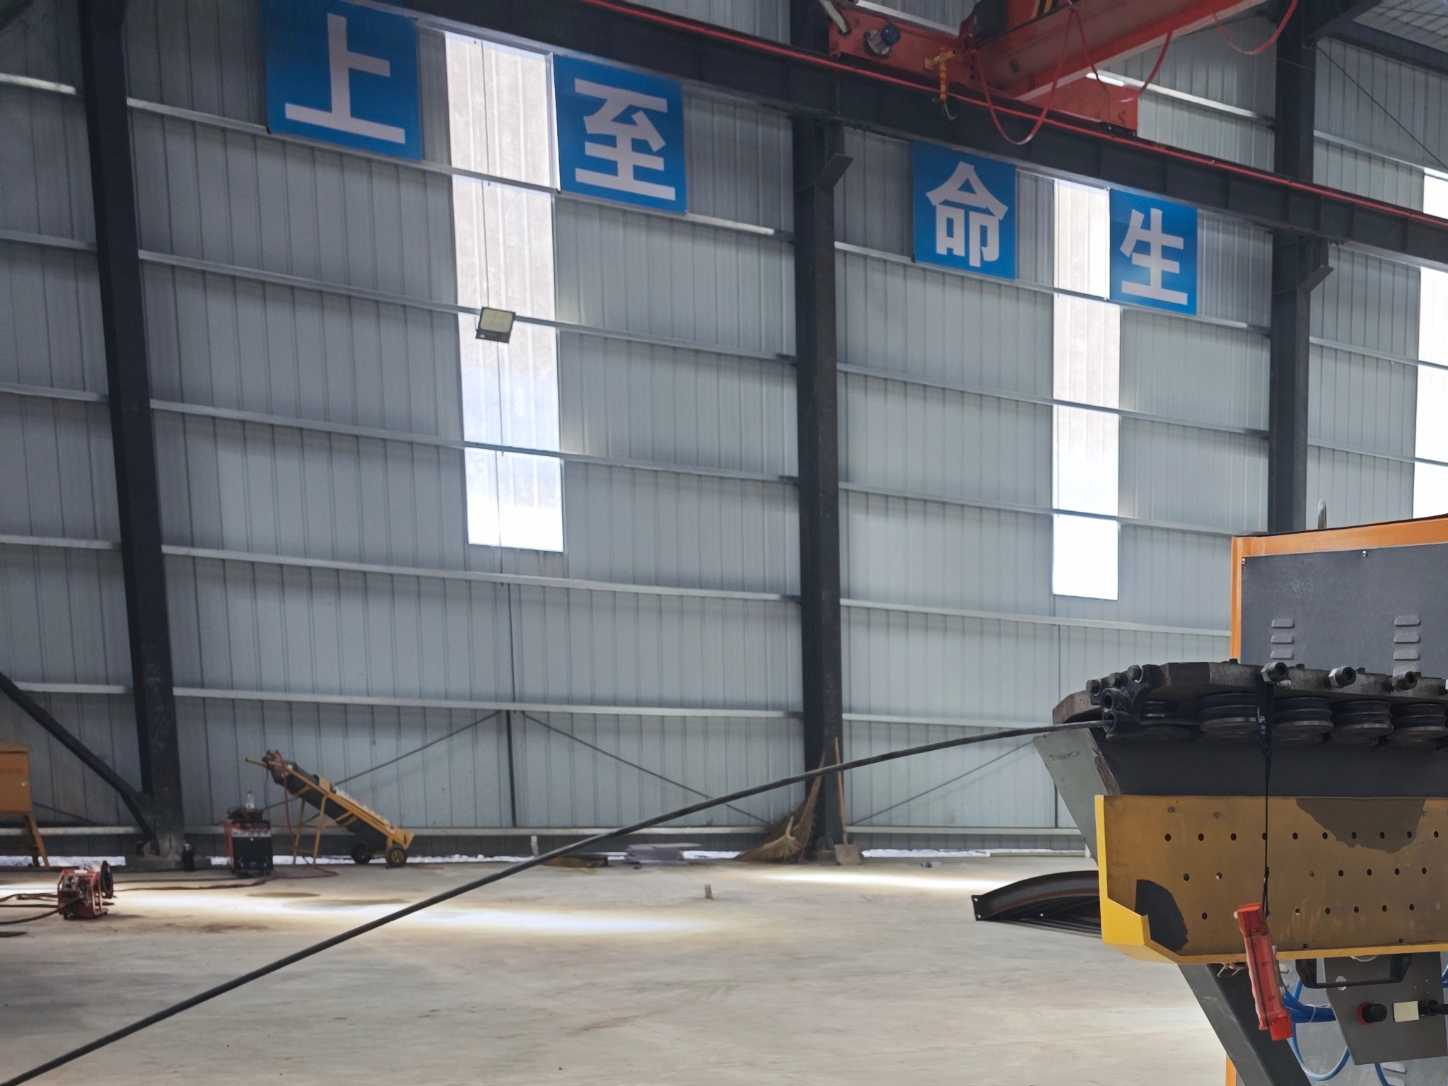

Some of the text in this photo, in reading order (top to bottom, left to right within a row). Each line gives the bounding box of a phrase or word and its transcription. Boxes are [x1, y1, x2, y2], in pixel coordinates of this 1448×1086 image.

[283, 13, 406, 144] 上
[574, 79, 677, 200] 至
[926, 161, 1008, 268] 命
[1119, 208, 1189, 306] 生
